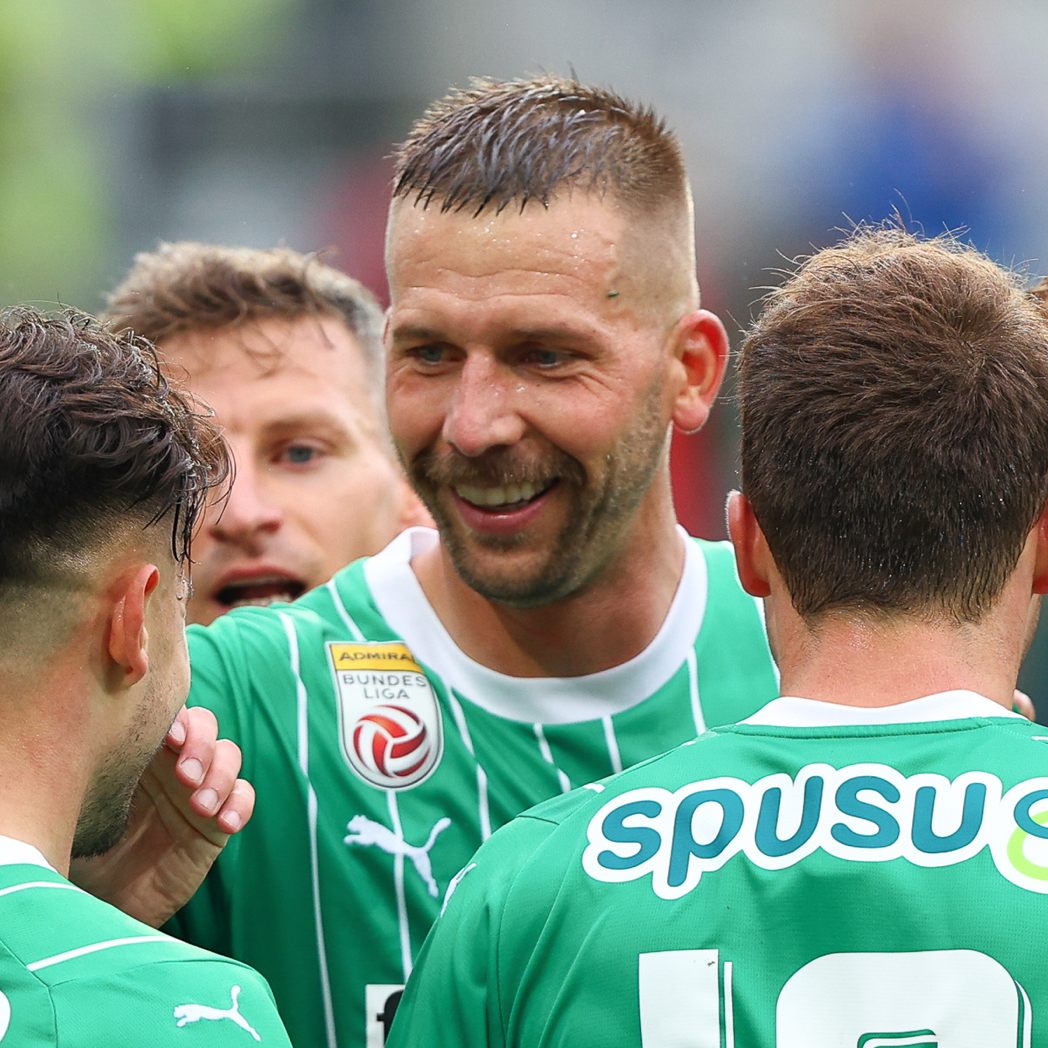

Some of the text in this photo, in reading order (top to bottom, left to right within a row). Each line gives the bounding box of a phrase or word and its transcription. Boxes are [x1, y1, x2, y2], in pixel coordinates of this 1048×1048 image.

[339, 652, 417, 662] ADMIRA
[342, 674, 428, 688] BUNDES
[363, 688, 411, 700] LIGA
[596, 774, 983, 888] spusu
